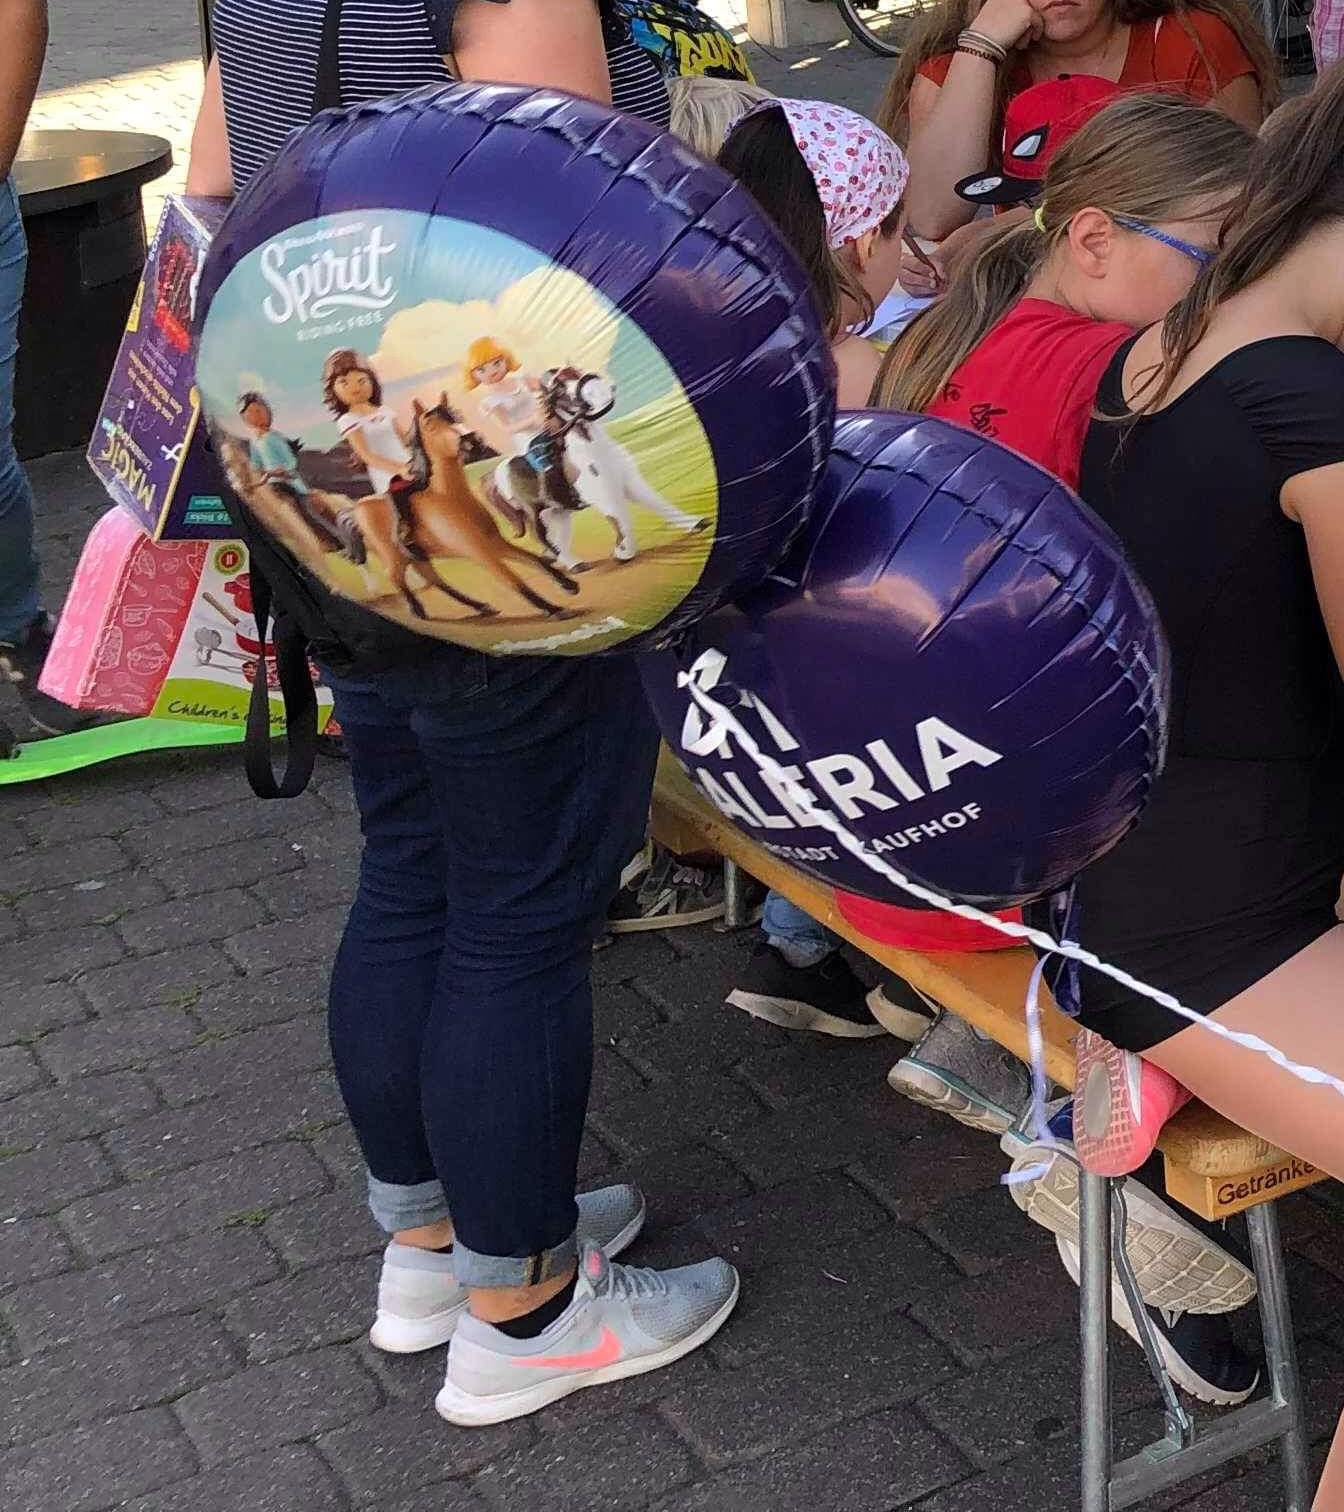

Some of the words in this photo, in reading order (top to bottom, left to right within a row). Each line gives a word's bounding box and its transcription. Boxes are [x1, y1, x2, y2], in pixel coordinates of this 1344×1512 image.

[260, 224, 399, 324] Spirit
[167, 699, 240, 721] Children's
[1216, 1159, 1315, 1205] Getränke
